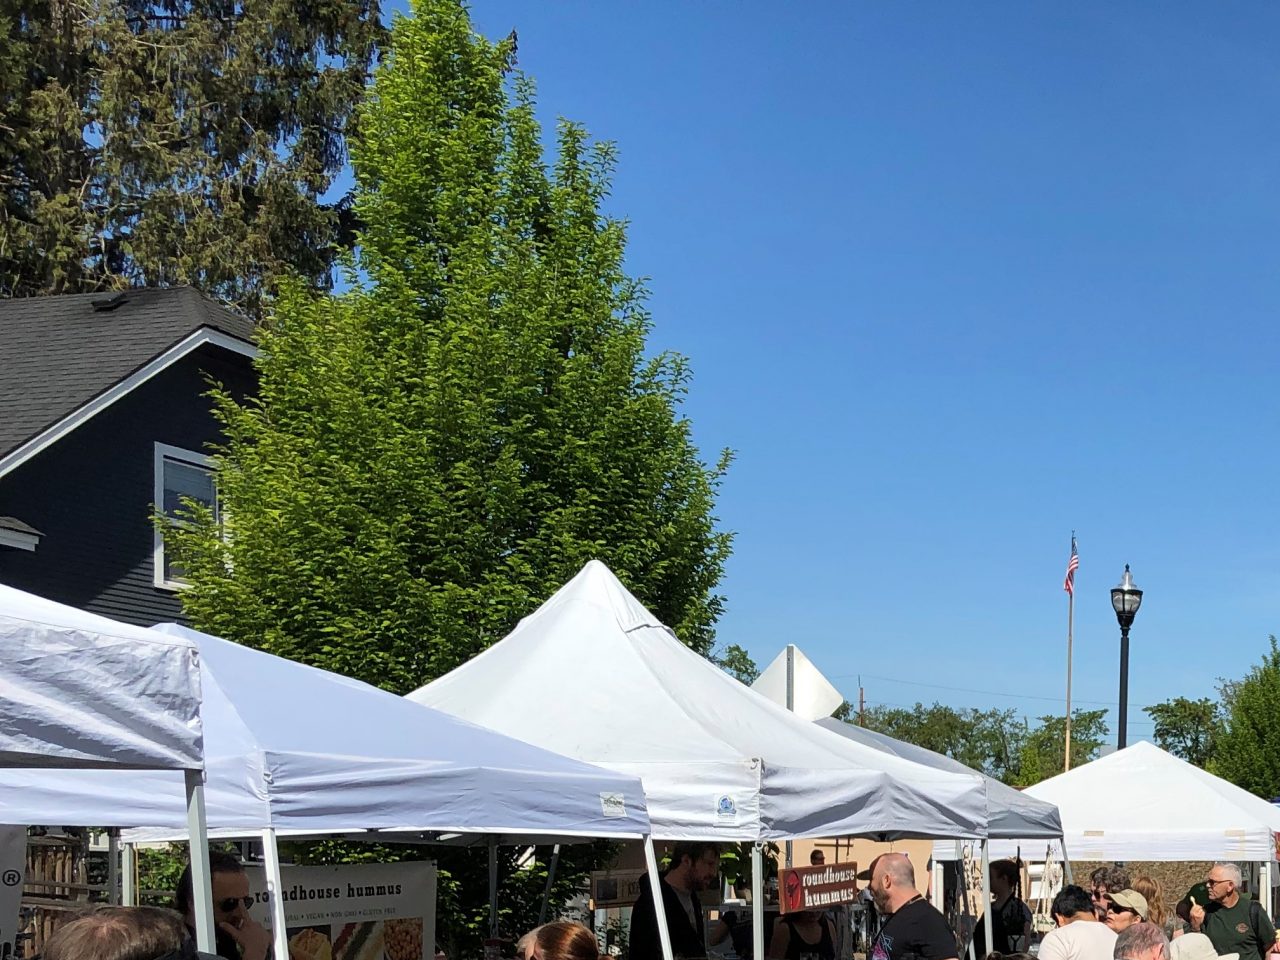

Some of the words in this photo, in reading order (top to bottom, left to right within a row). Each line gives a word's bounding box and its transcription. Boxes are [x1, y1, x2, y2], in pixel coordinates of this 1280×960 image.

[802, 866, 856, 887] roundhouse
[254, 885, 341, 904] rondhouse
[347, 882, 402, 898] hummus
[804, 887, 854, 907] hummus
